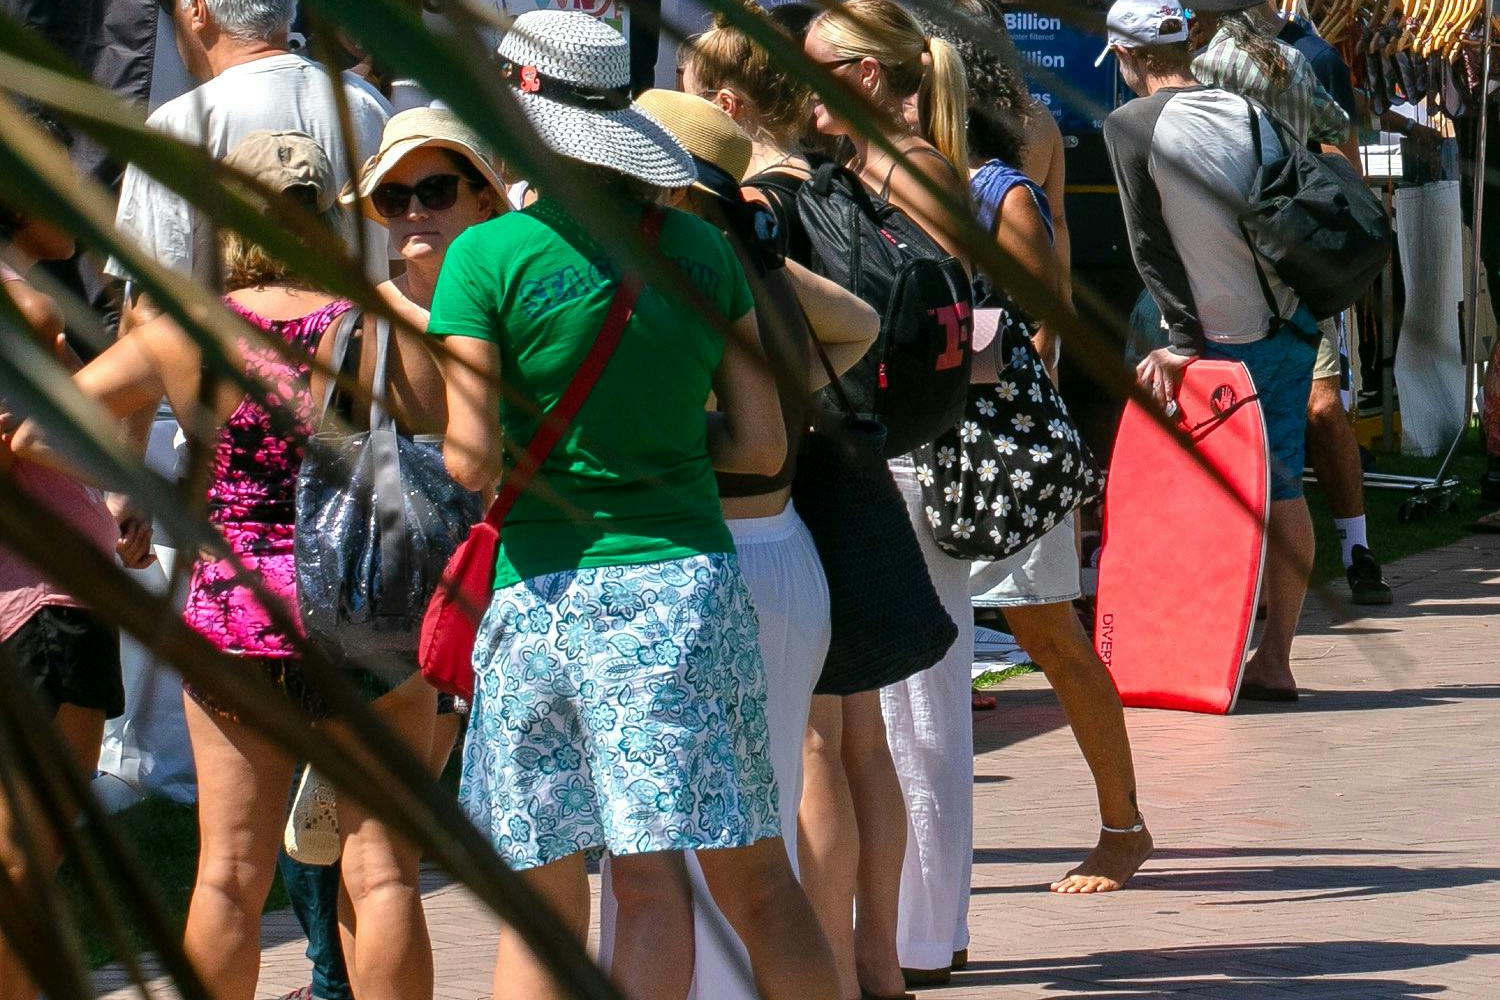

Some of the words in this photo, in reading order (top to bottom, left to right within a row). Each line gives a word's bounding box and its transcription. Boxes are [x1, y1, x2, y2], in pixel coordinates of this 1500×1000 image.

[1004, 13, 1061, 30] Billion
[1019, 51, 1065, 68] illion
[1100, 612, 1115, 668] DIVERT
